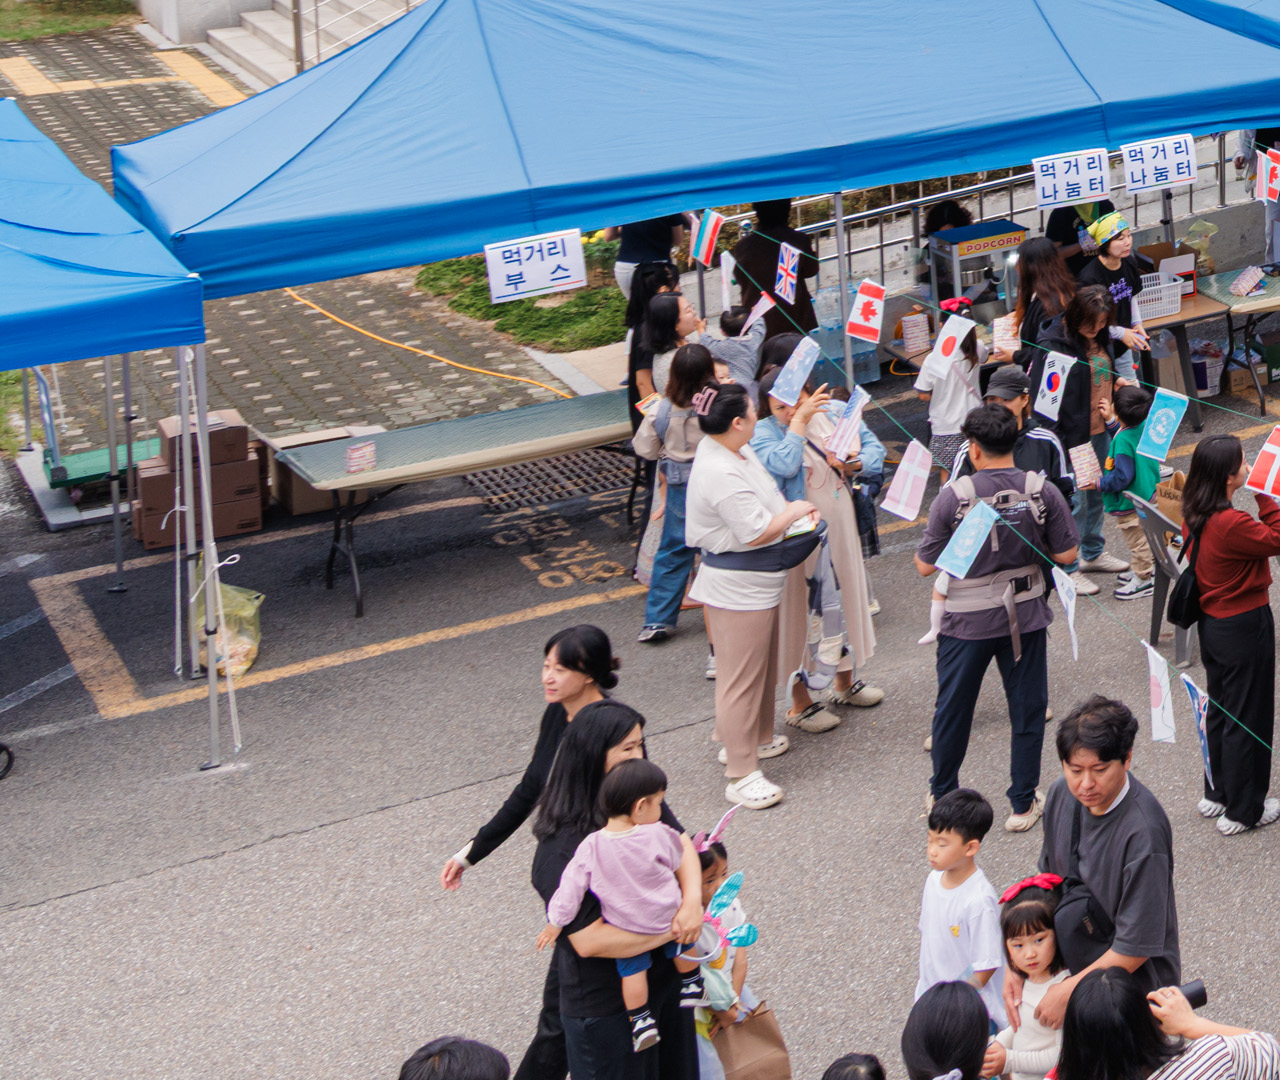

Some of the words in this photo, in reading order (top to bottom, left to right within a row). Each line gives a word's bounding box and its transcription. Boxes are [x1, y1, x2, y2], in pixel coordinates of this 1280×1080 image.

[1129, 138, 1190, 164] 먹거리
[1040, 154, 1103, 179] 먹거리
[1130, 160, 1192, 186] 나눔터
[1041, 177, 1105, 201] 나눔터
[501, 240, 567, 267] 먹거리
[966, 235, 1021, 253] POPCORN
[505, 262, 573, 291] 부스
